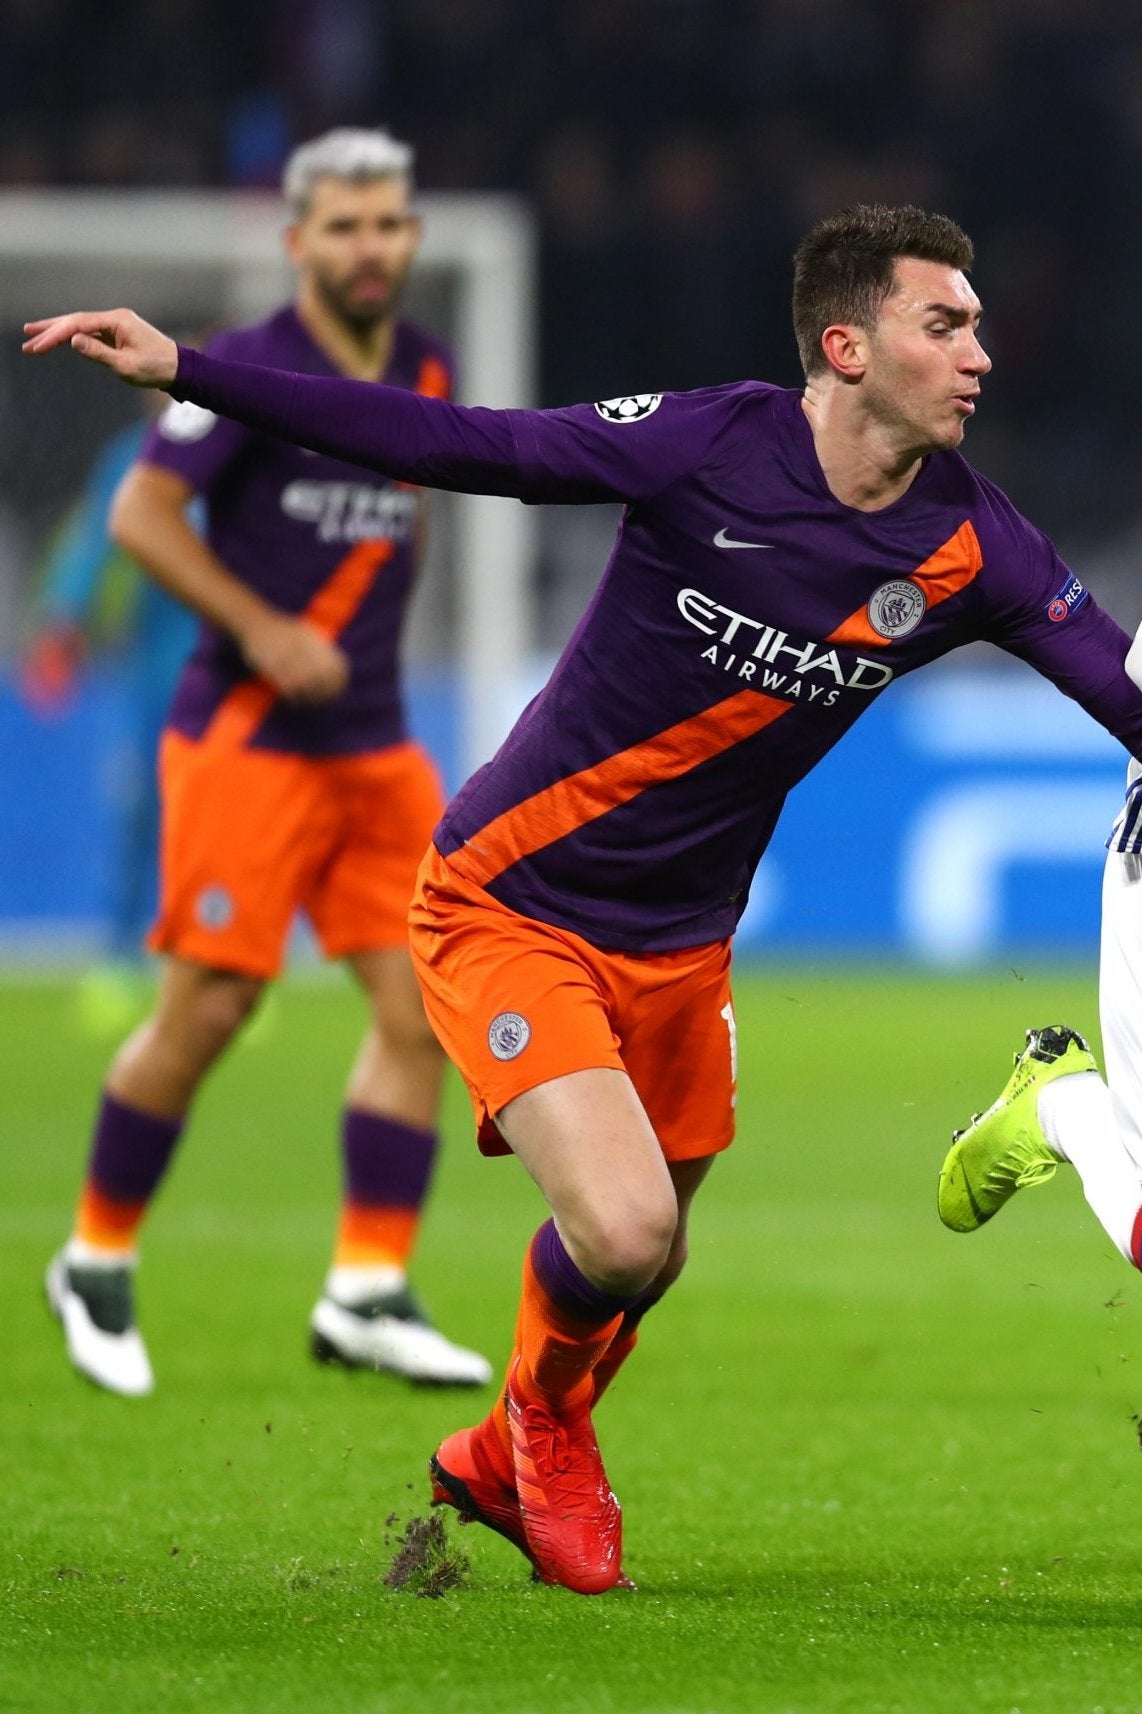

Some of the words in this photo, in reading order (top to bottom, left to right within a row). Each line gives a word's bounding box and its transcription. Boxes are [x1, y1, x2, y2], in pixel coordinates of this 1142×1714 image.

[880, 583, 923, 609] MANCHESTER
[676, 587, 894, 690] ETIHAD
[879, 625, 897, 636] CITY
[700, 644, 840, 707] AIRWAYS
